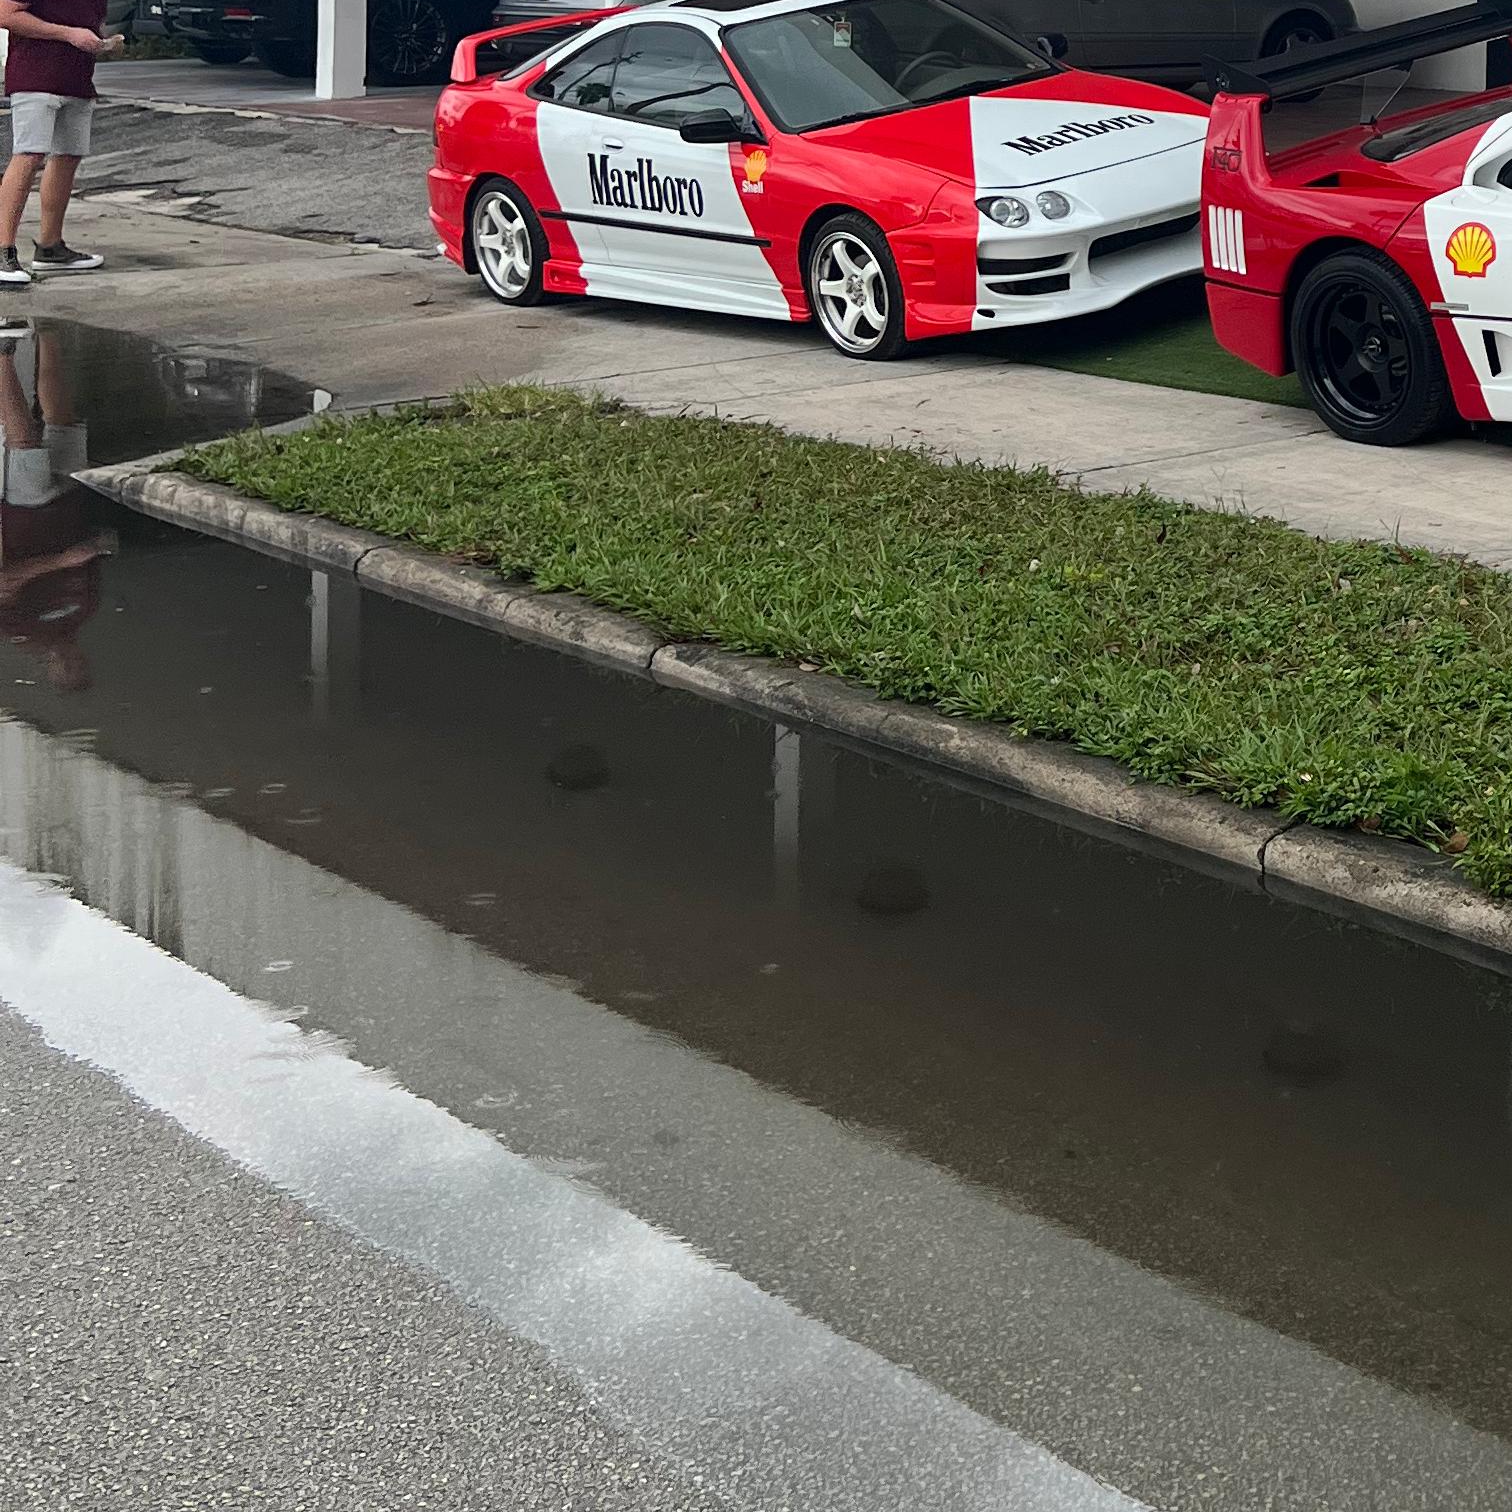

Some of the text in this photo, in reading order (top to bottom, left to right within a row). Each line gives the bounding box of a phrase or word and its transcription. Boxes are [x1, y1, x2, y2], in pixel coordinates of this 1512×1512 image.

[1001, 113, 1155, 156] Marlboro
[587, 153, 704, 218] Marlboro
[742, 180, 764, 193] Shell
